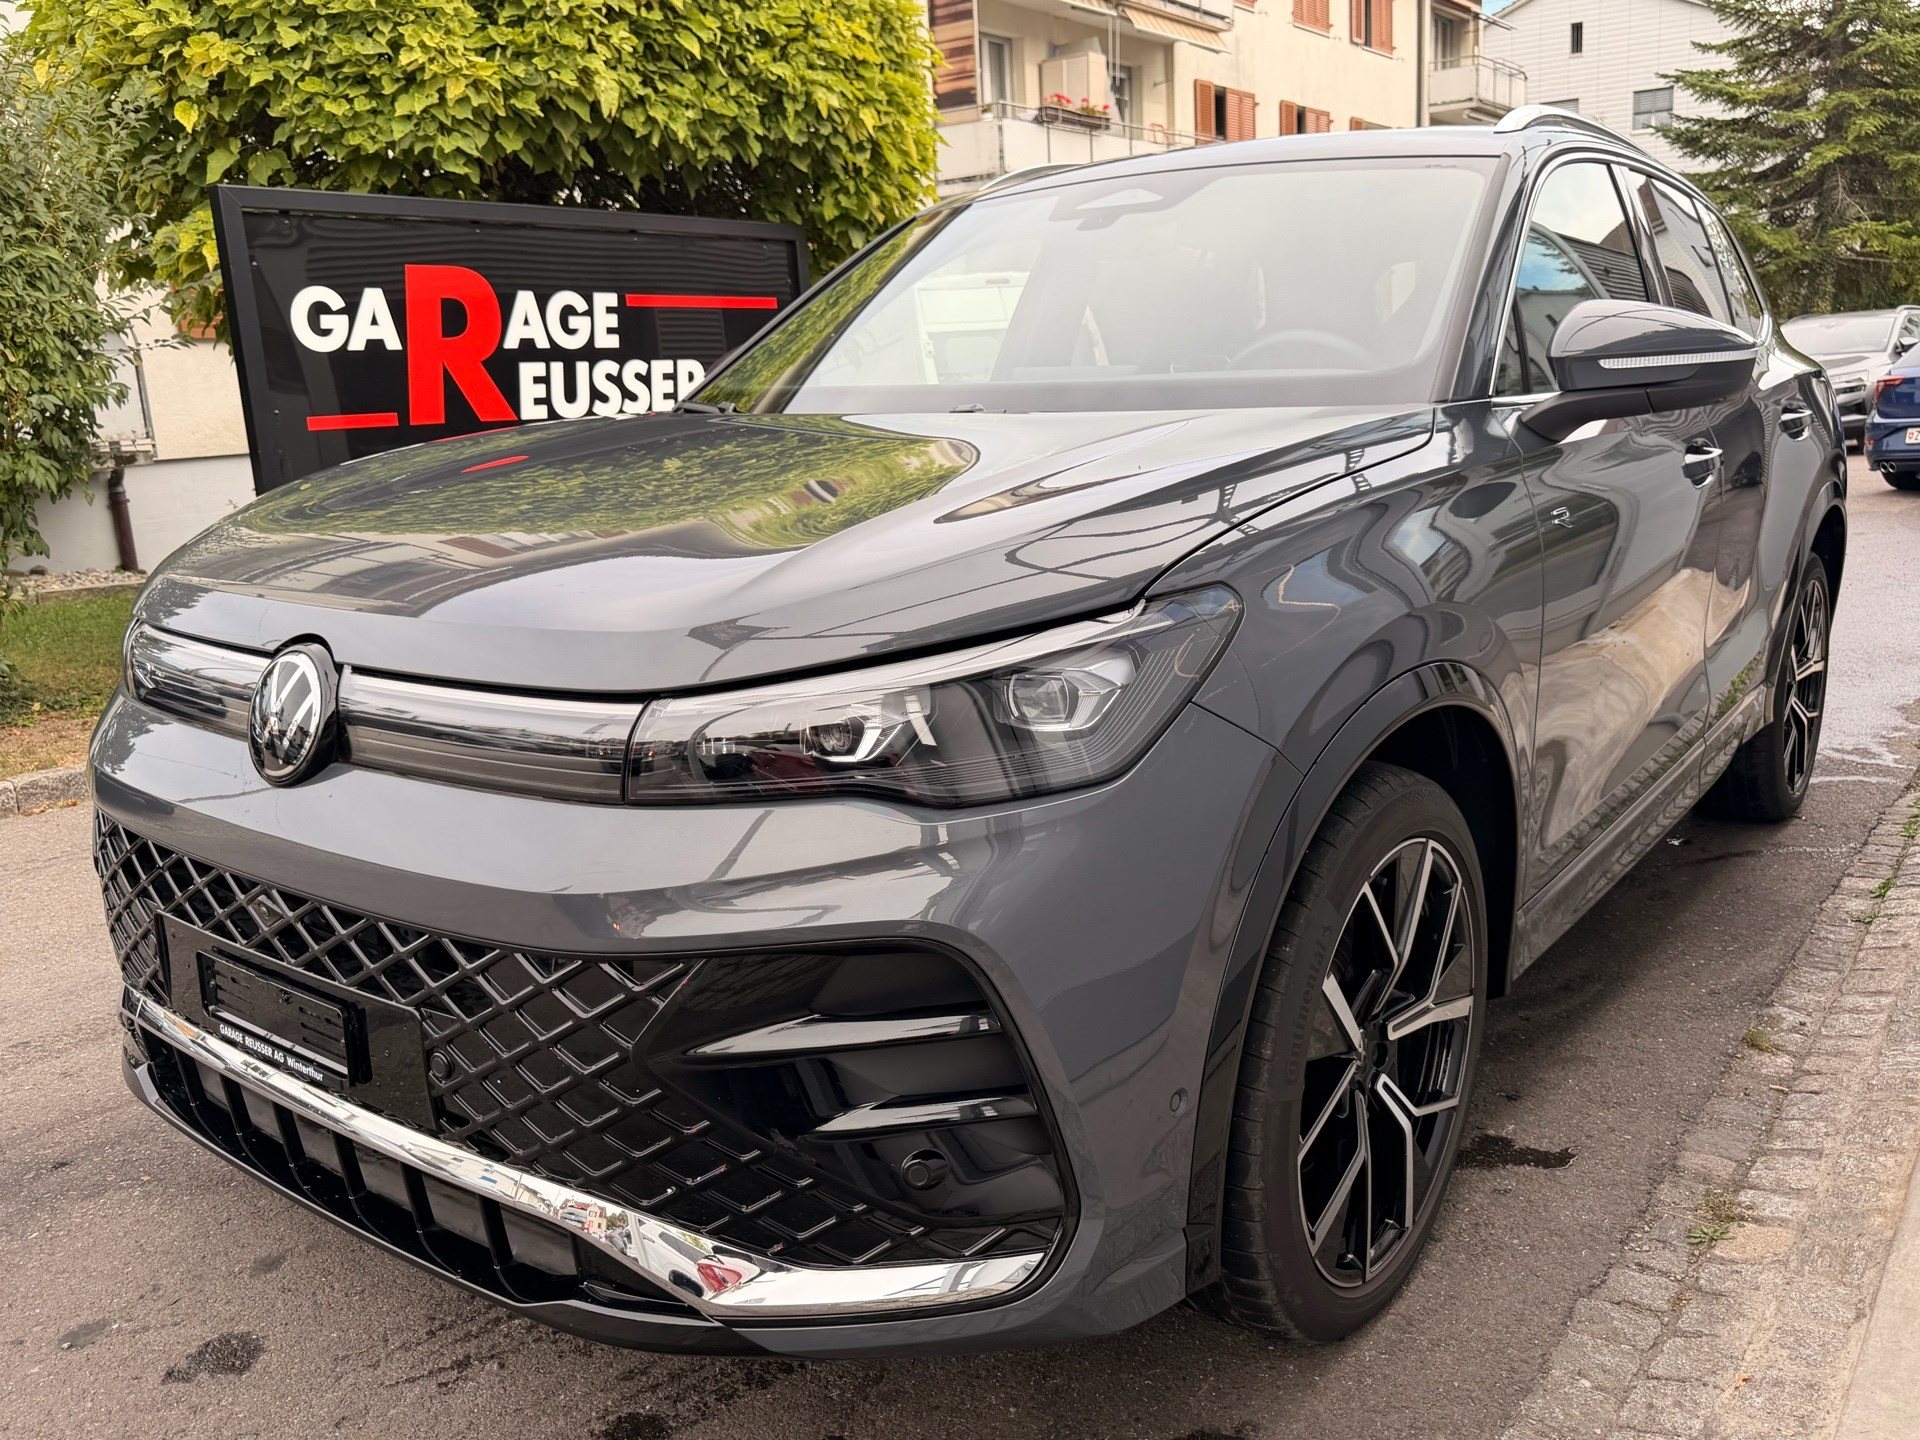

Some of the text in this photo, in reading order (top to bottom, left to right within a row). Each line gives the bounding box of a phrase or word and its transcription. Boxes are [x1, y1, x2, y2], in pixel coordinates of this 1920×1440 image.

[290, 264, 619, 425] GARAGE
[1550, 506, 1574, 529] R
[220, 1024, 324, 1081] GARAGE REUSSER AG Winterthur
